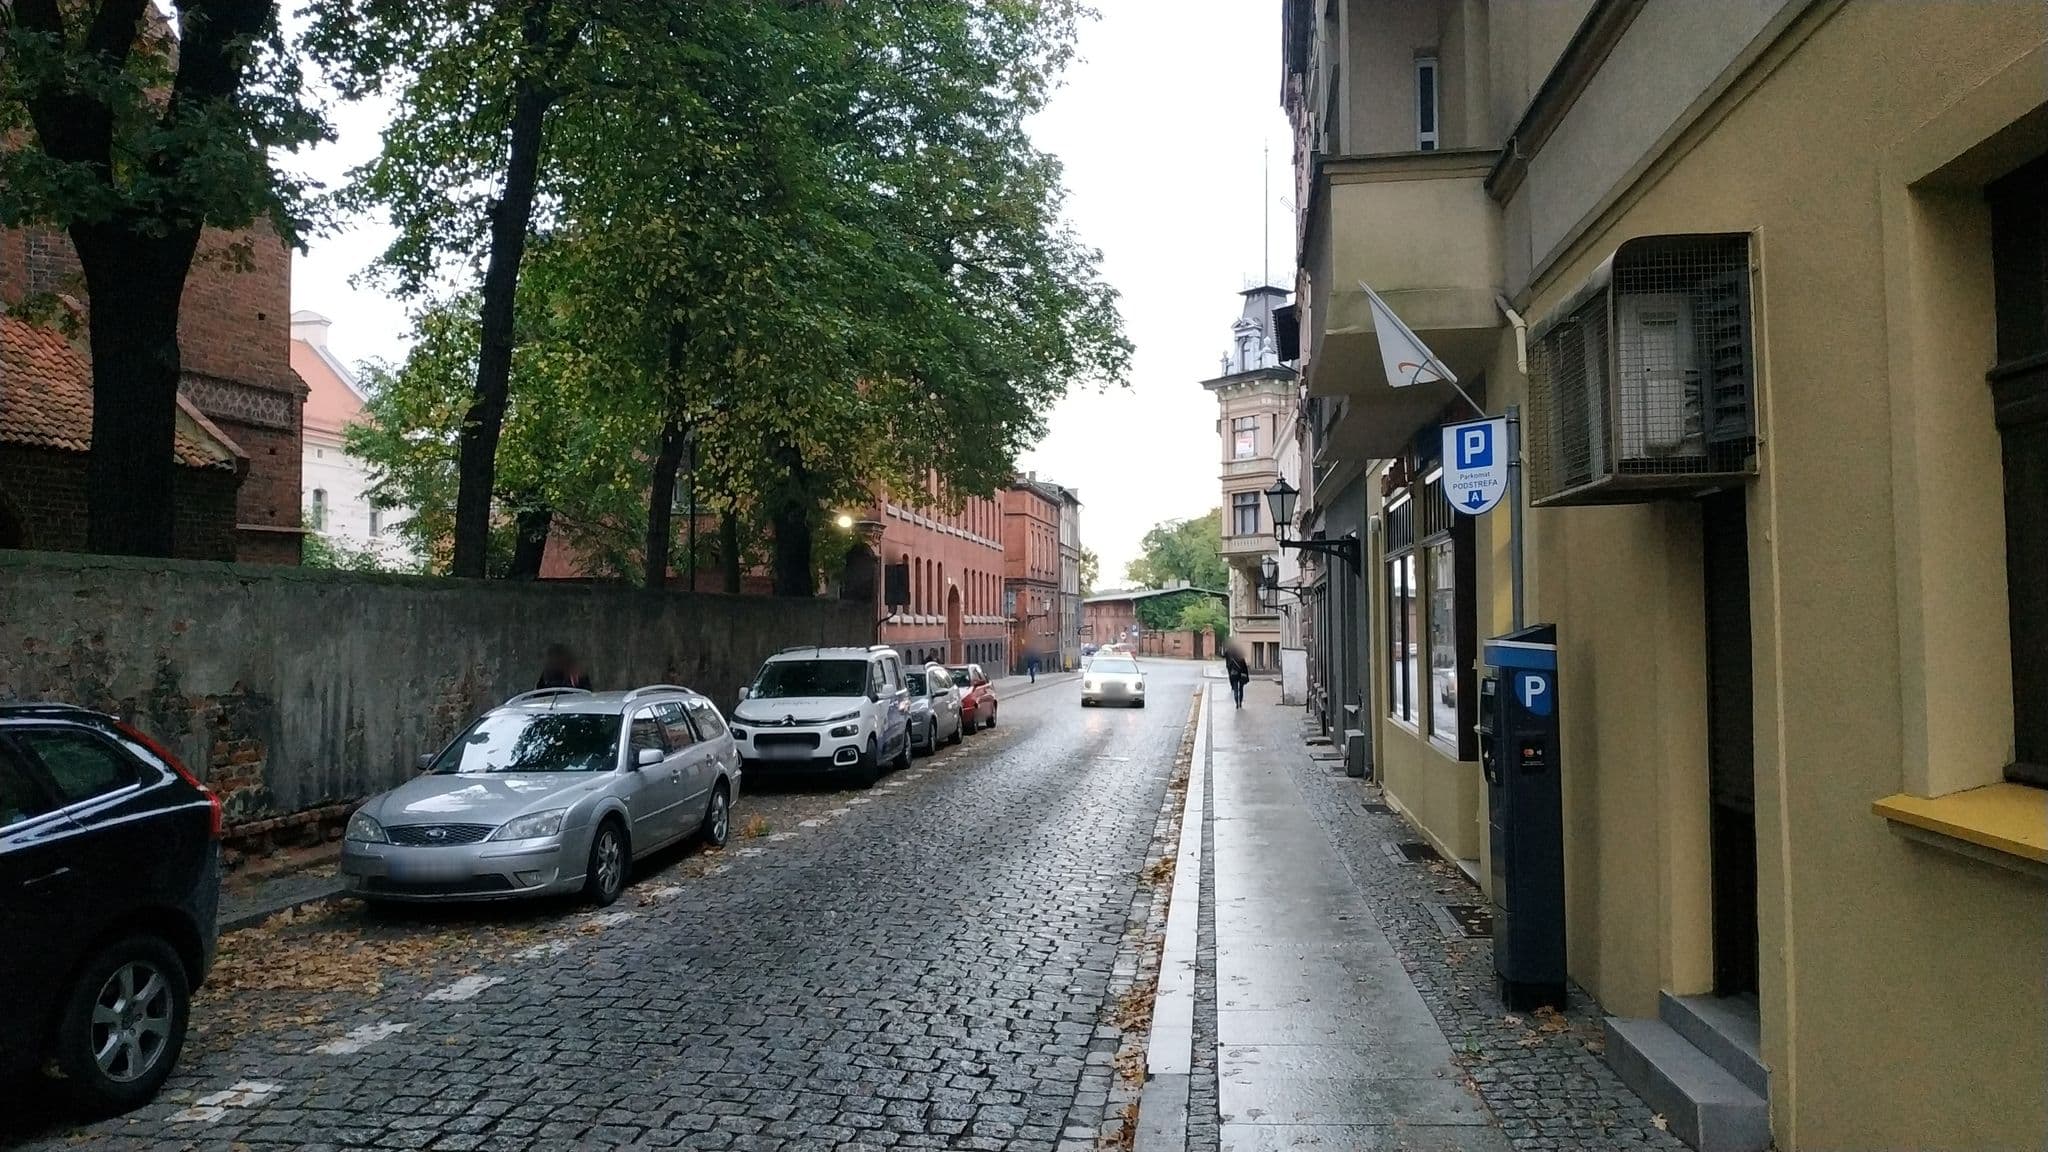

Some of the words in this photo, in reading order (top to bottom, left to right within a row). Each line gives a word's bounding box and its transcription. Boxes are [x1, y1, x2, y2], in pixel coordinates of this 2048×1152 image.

[1464, 430, 1486, 465] P
[1460, 472, 1490, 480] Parkomat
[1453, 480, 1498, 489] PODSTREFA
[1471, 491, 1480, 502] A
[1525, 676, 1546, 708] P
